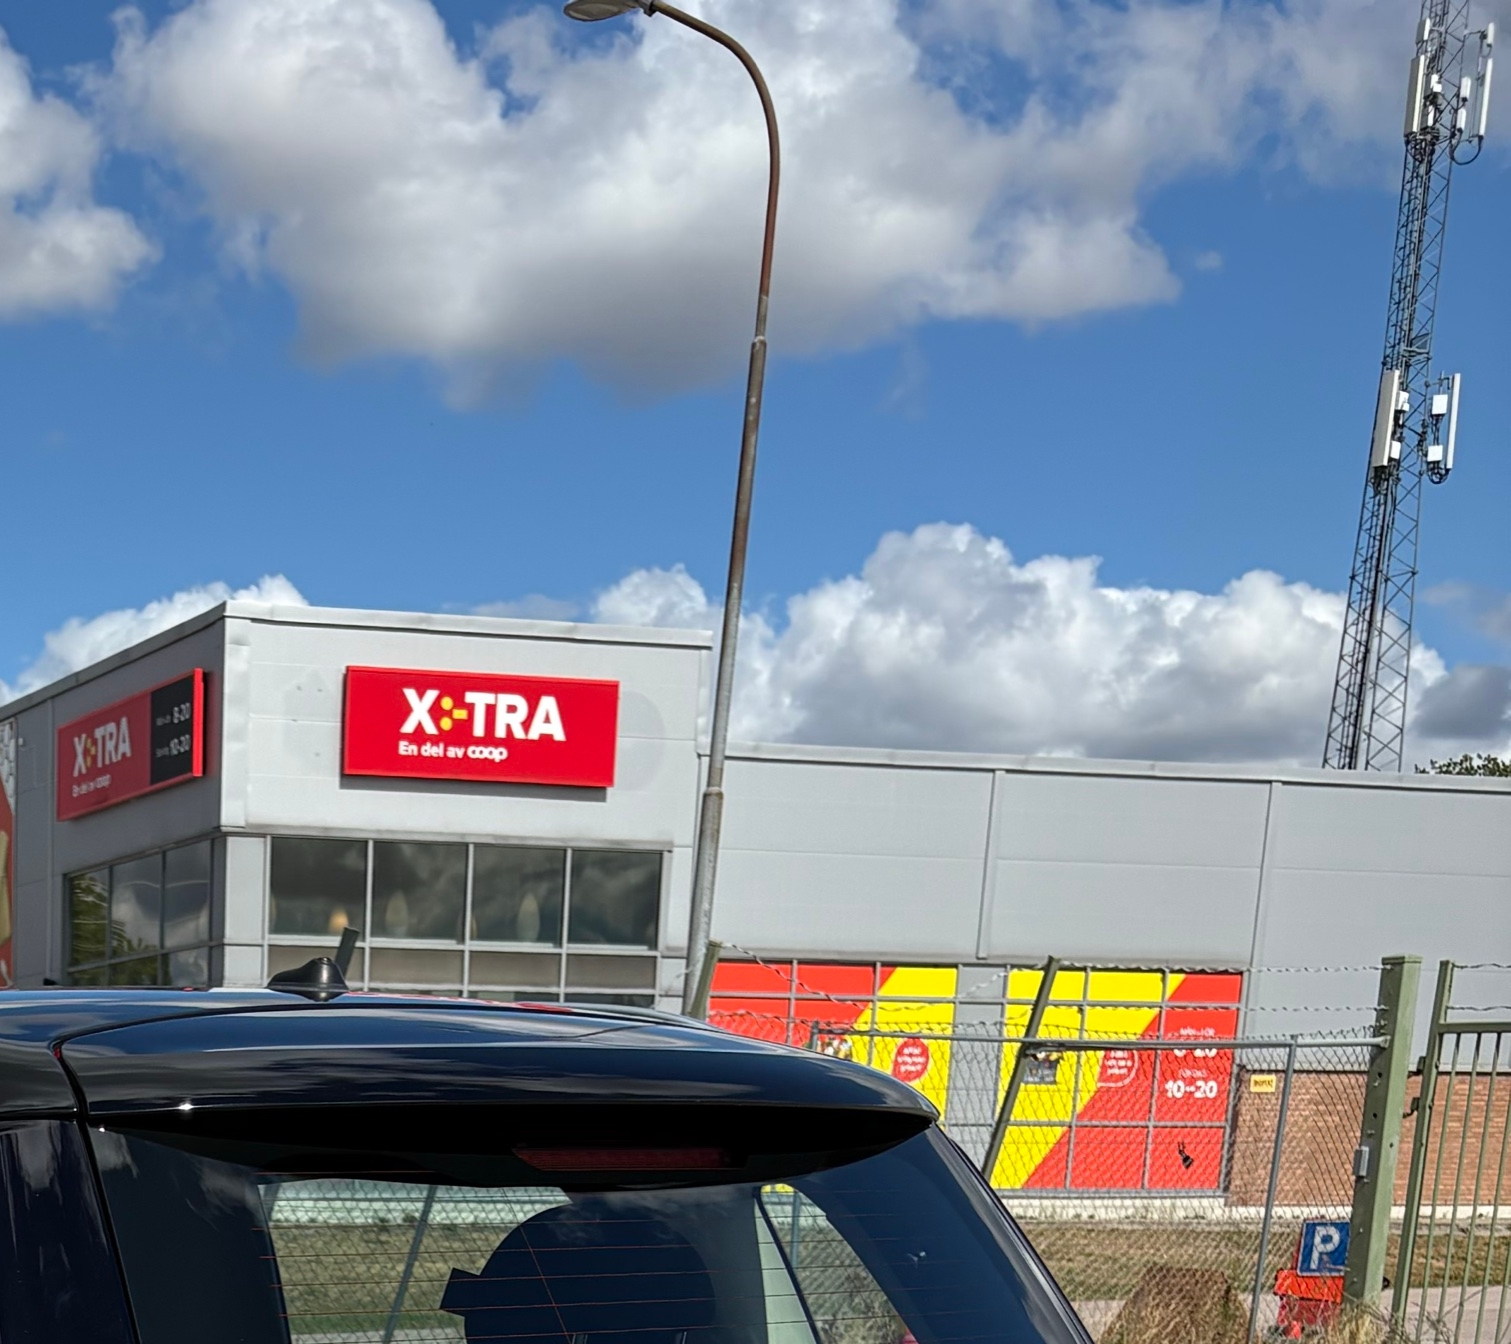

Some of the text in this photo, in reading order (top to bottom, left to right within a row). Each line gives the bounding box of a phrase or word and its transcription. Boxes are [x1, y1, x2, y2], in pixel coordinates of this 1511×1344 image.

[398, 740, 508, 762] En del av coop
[1310, 1226, 1340, 1270] P
